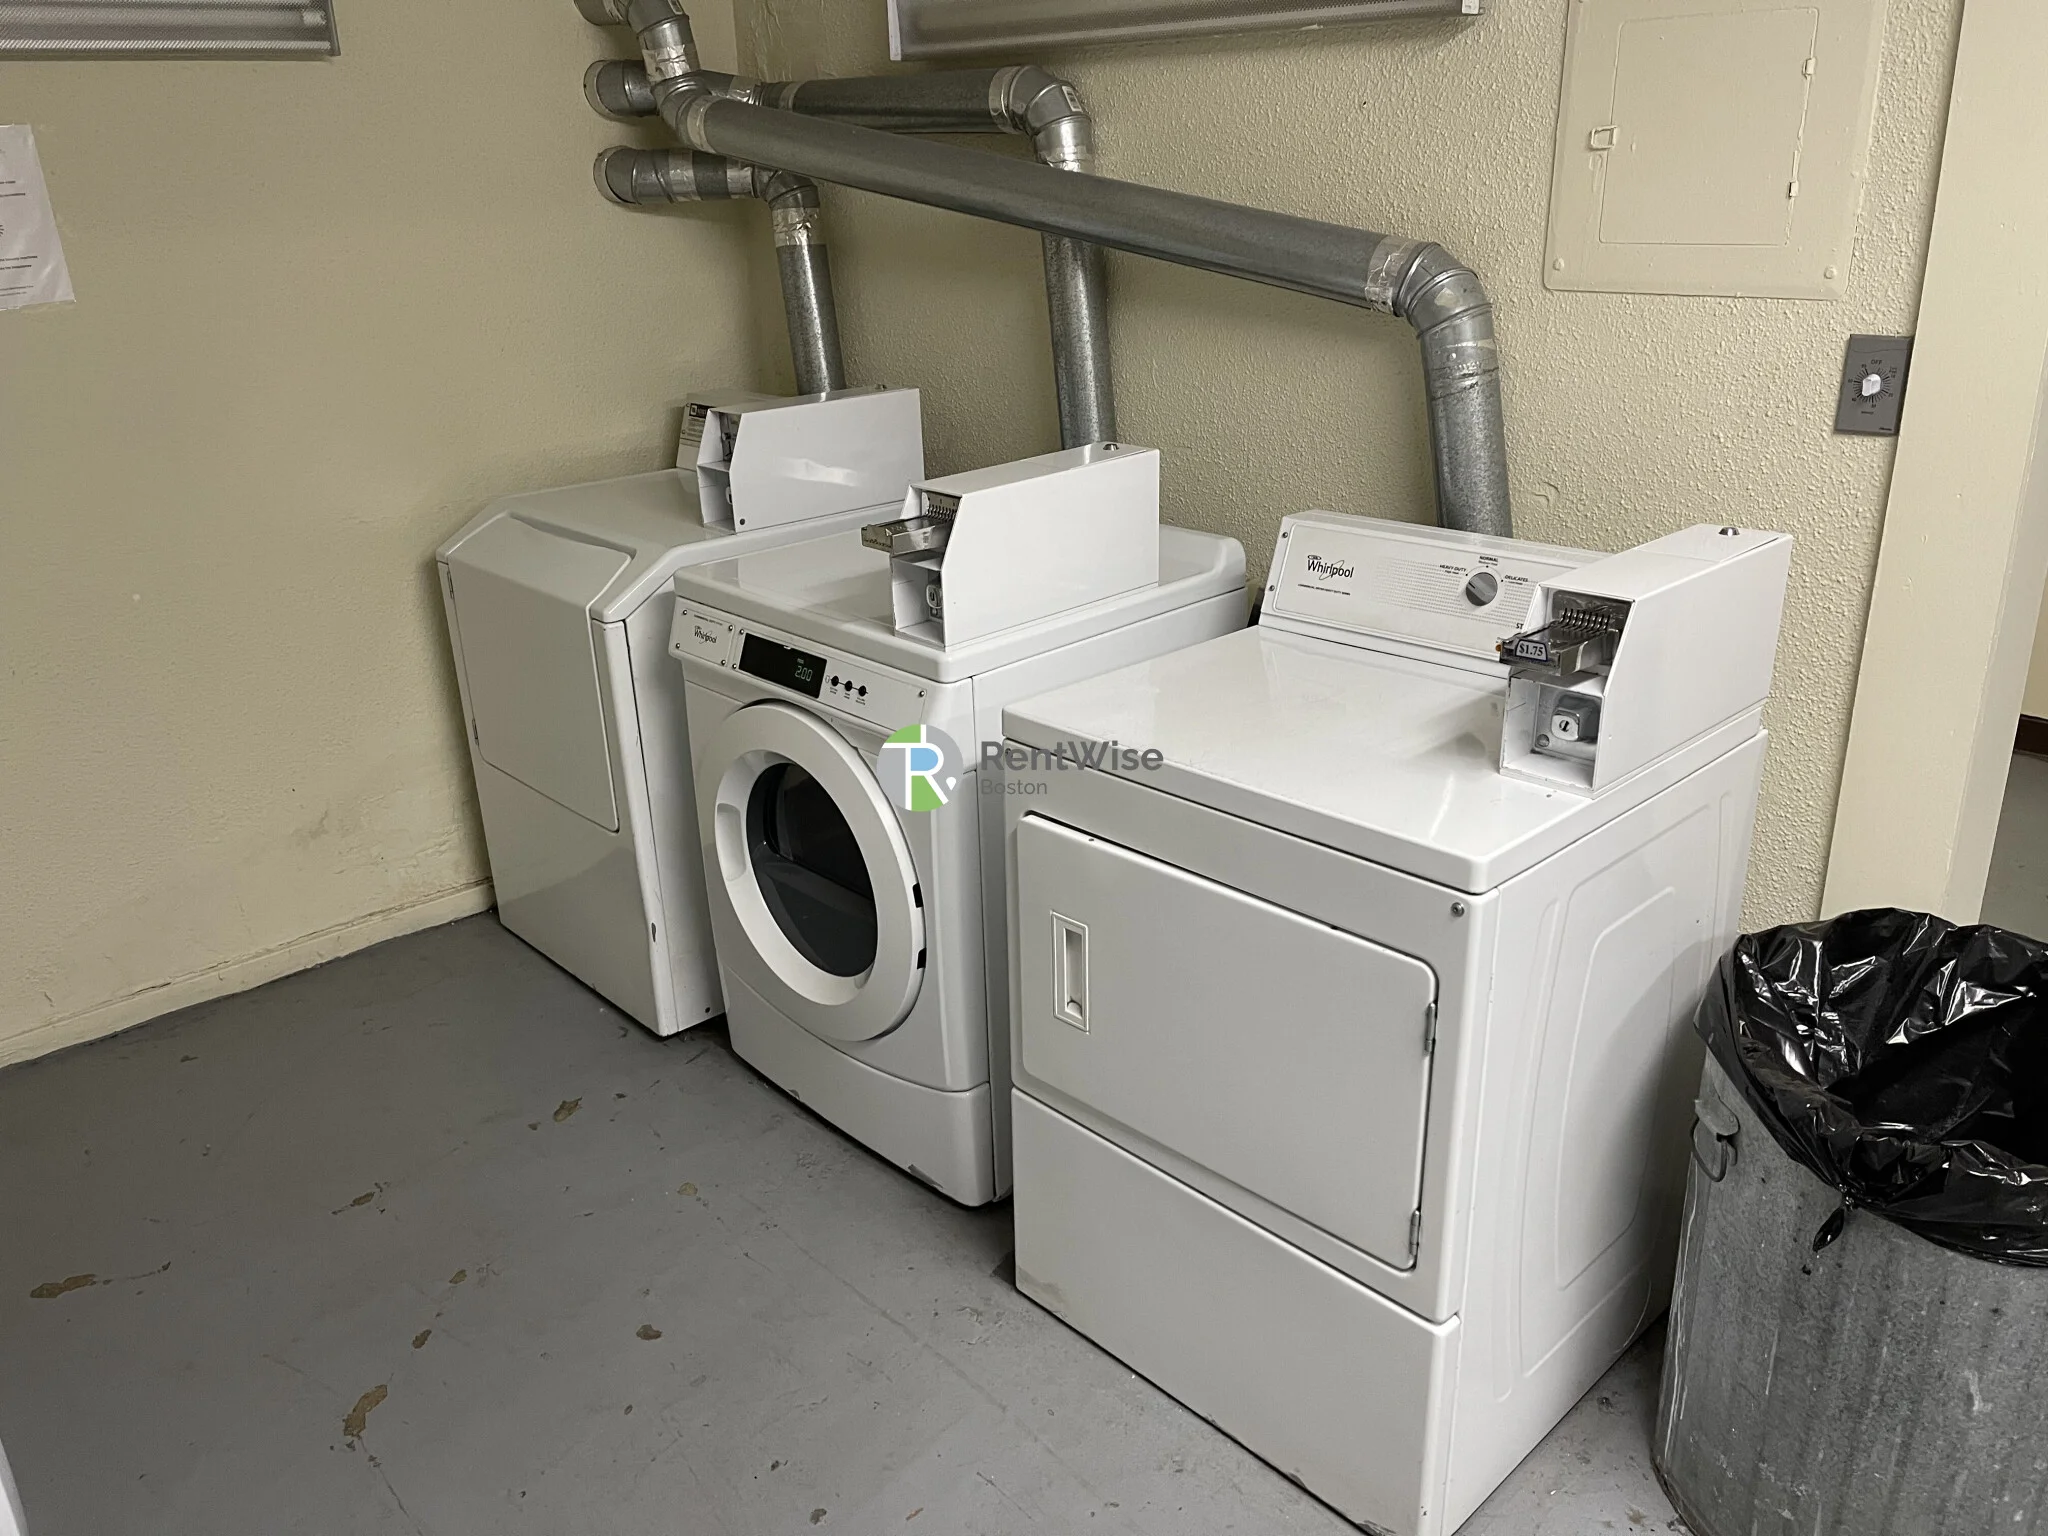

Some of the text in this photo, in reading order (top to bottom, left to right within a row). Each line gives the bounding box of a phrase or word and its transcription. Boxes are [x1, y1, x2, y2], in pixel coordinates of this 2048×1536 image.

[1307, 559, 1355, 579] Whirlpool
[694, 628, 718, 644] Whirlpool
[1518, 642, 1544, 657] $1.75
